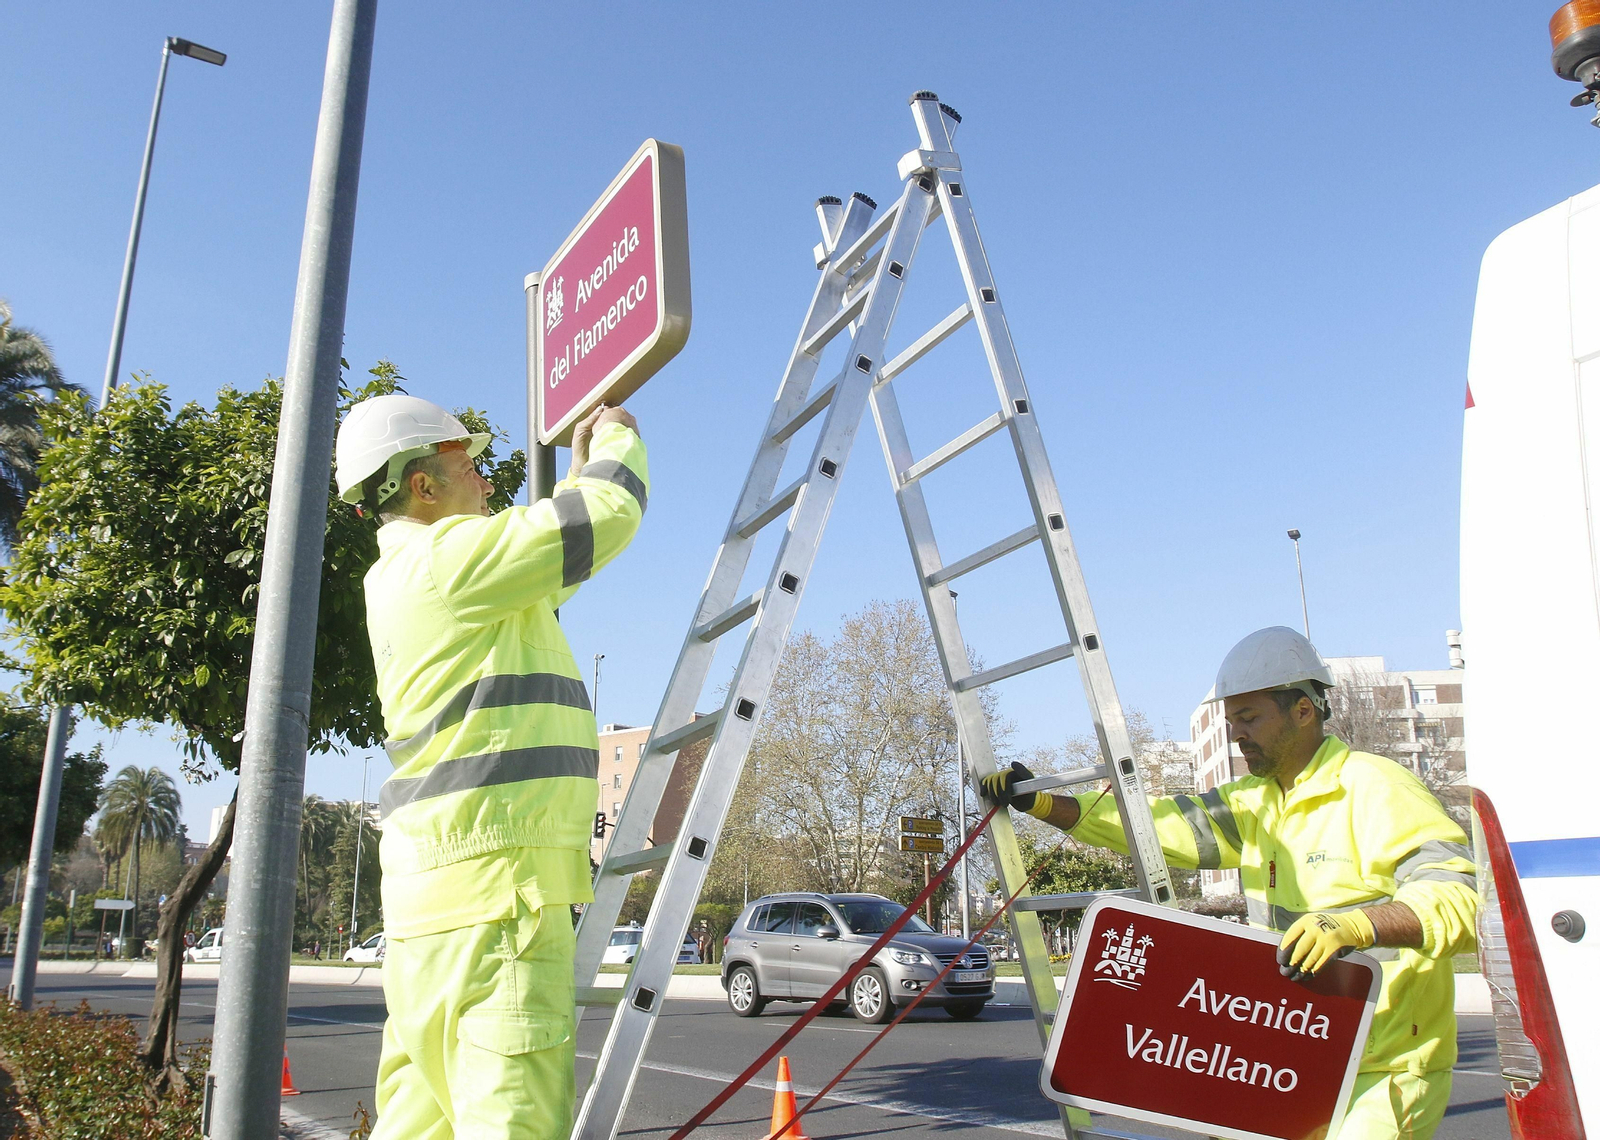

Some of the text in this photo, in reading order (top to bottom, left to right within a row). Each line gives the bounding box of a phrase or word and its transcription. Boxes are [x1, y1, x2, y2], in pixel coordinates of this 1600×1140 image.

[574, 226, 640, 313] Avenida
[550, 275, 648, 389] del Flamenco
[1306, 853, 1326, 864] API
[1177, 977, 1330, 1040] Avenida
[1125, 1023, 1299, 1093] Vallellano
